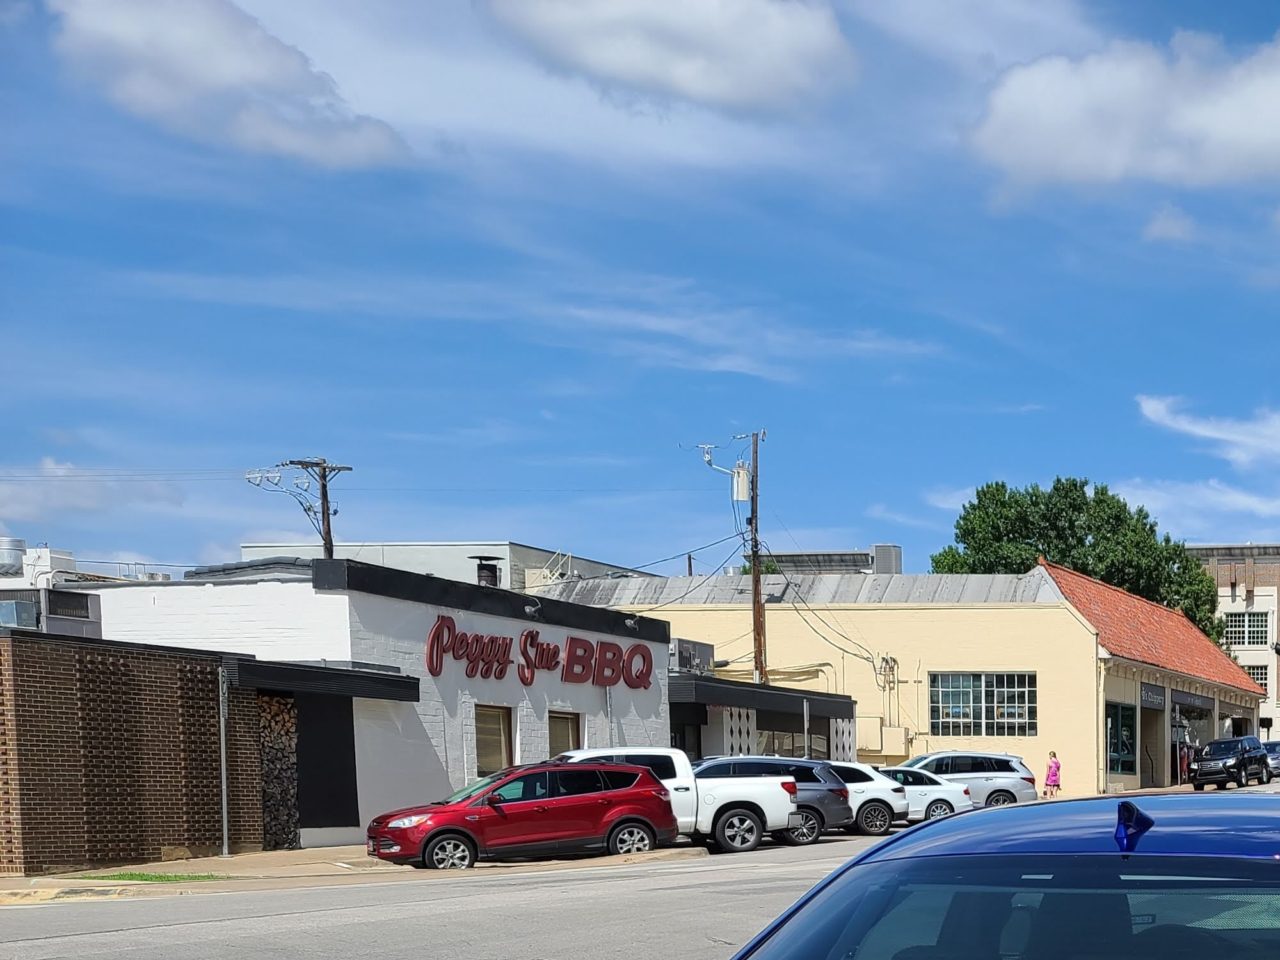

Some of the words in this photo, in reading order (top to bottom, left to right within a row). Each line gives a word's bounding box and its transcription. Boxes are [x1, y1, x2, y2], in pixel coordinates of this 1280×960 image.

[426, 615, 514, 680] Peggy
[517, 628, 560, 686] Sue
[561, 636, 653, 690] BBQ
